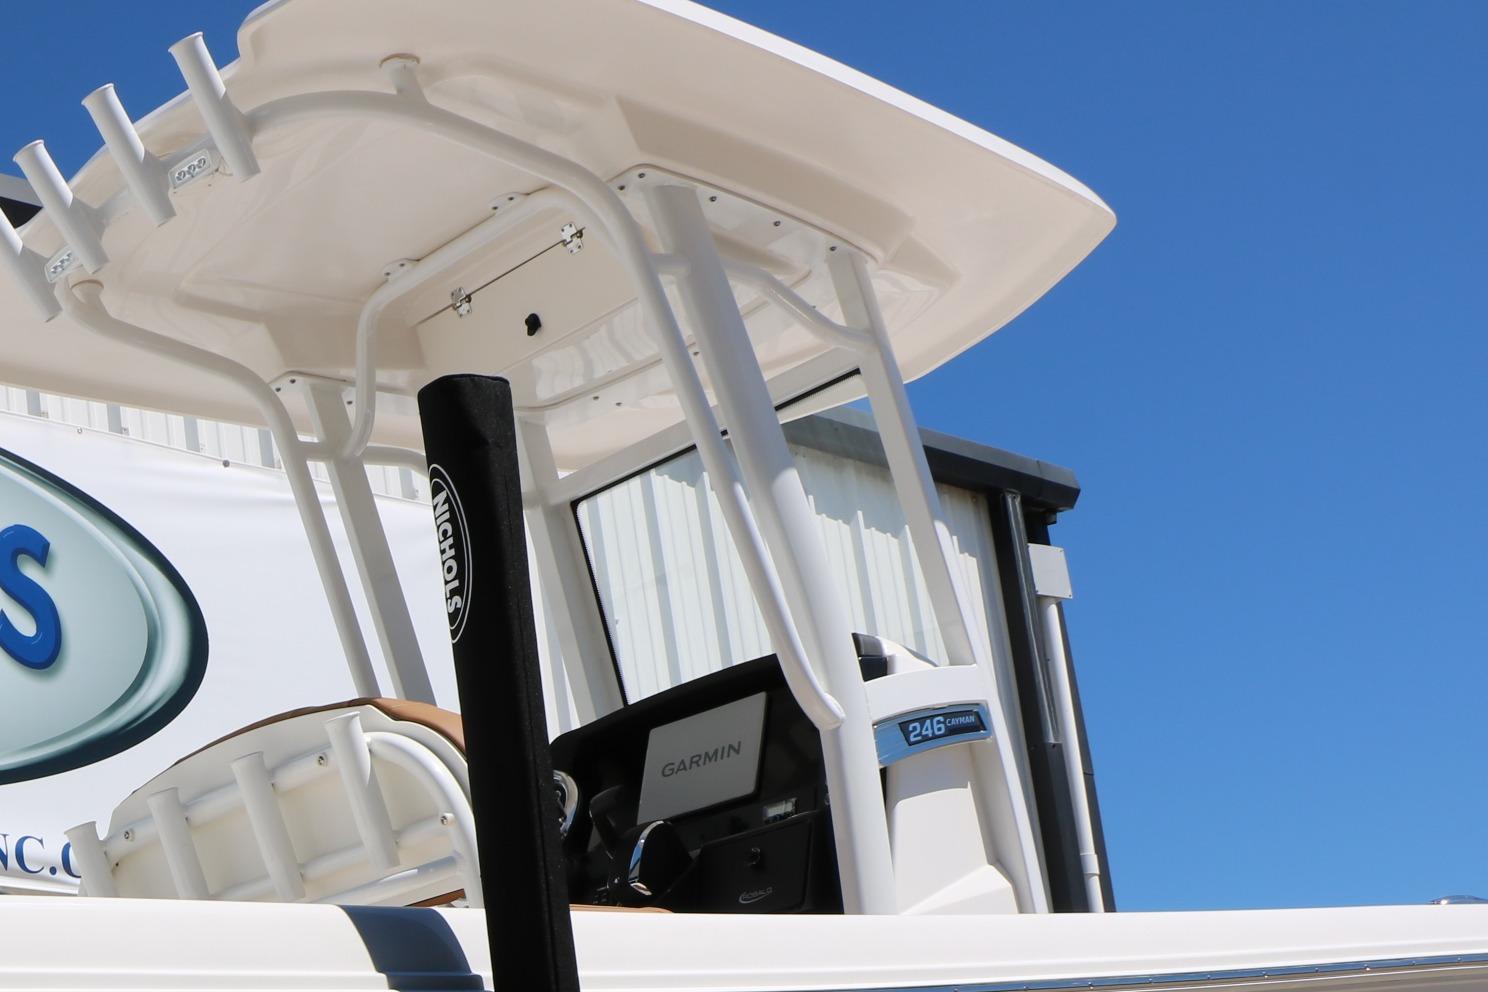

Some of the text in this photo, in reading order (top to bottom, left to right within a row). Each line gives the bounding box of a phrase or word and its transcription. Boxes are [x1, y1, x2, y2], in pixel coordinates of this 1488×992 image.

[432, 489, 463, 614] NICHOLS
[908, 714, 976, 743] 246 CAYMAN
[661, 740, 742, 778] GARMIN
